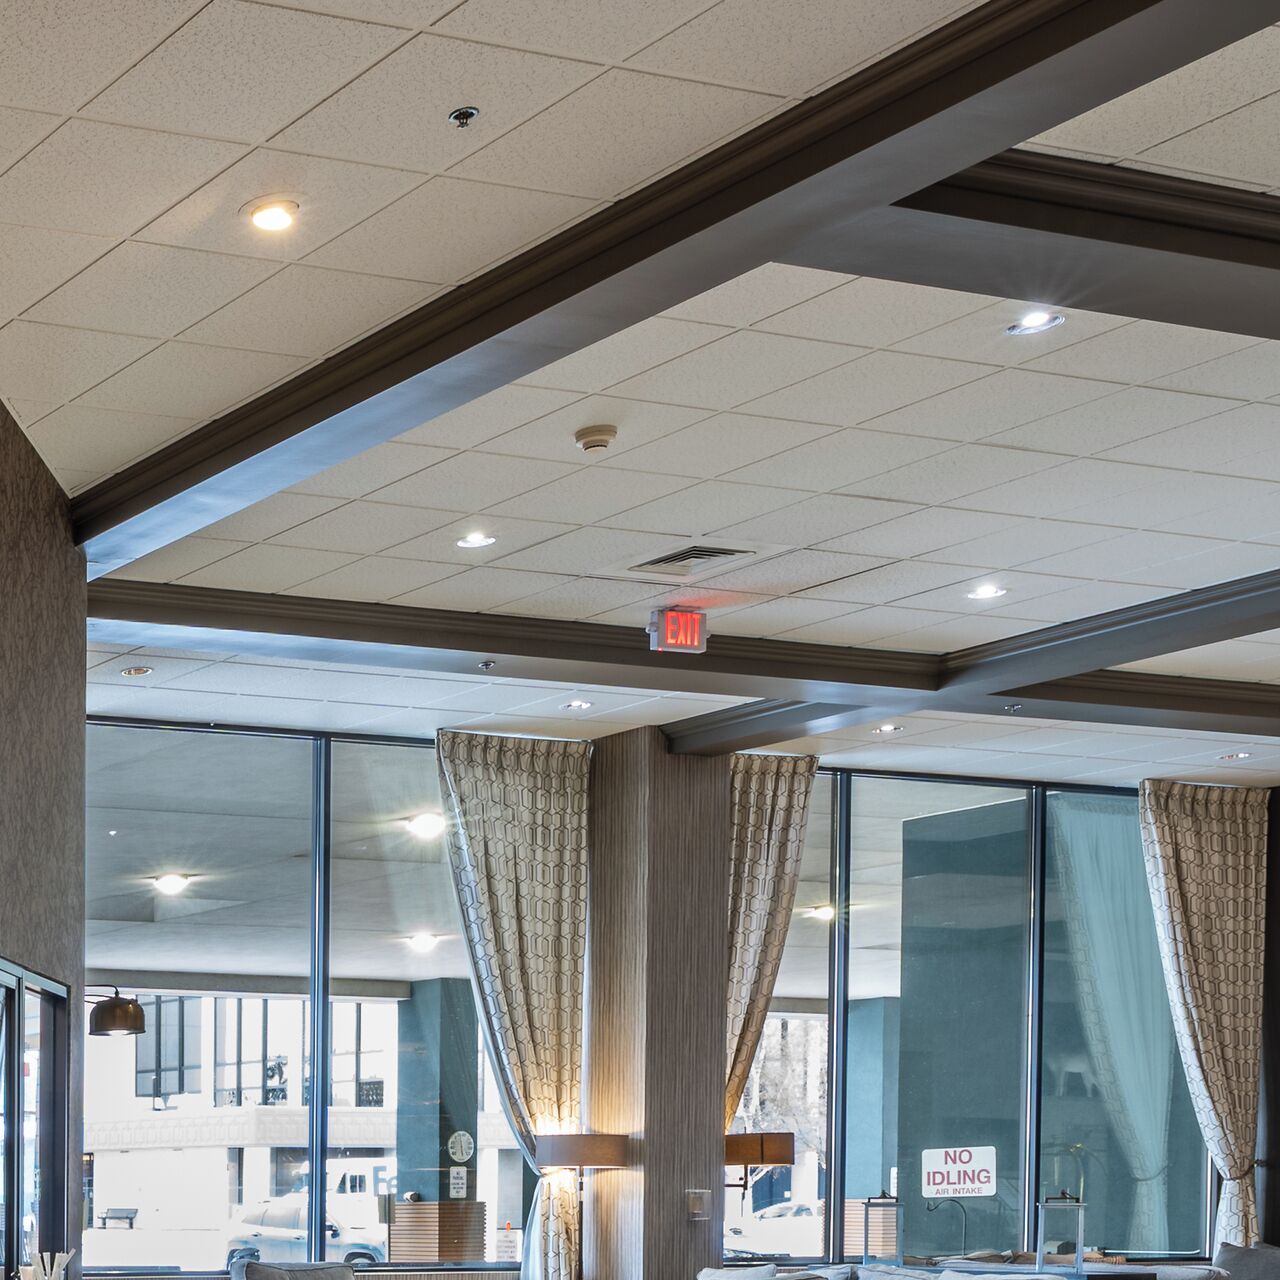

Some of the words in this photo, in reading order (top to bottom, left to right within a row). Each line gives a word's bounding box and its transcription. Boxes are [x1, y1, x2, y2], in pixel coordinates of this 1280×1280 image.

[666, 611, 702, 646] EXIT
[944, 1149, 973, 1165] NO
[927, 1168, 991, 1186] IDLING
[952, 1187, 983, 1195] INTAKE
